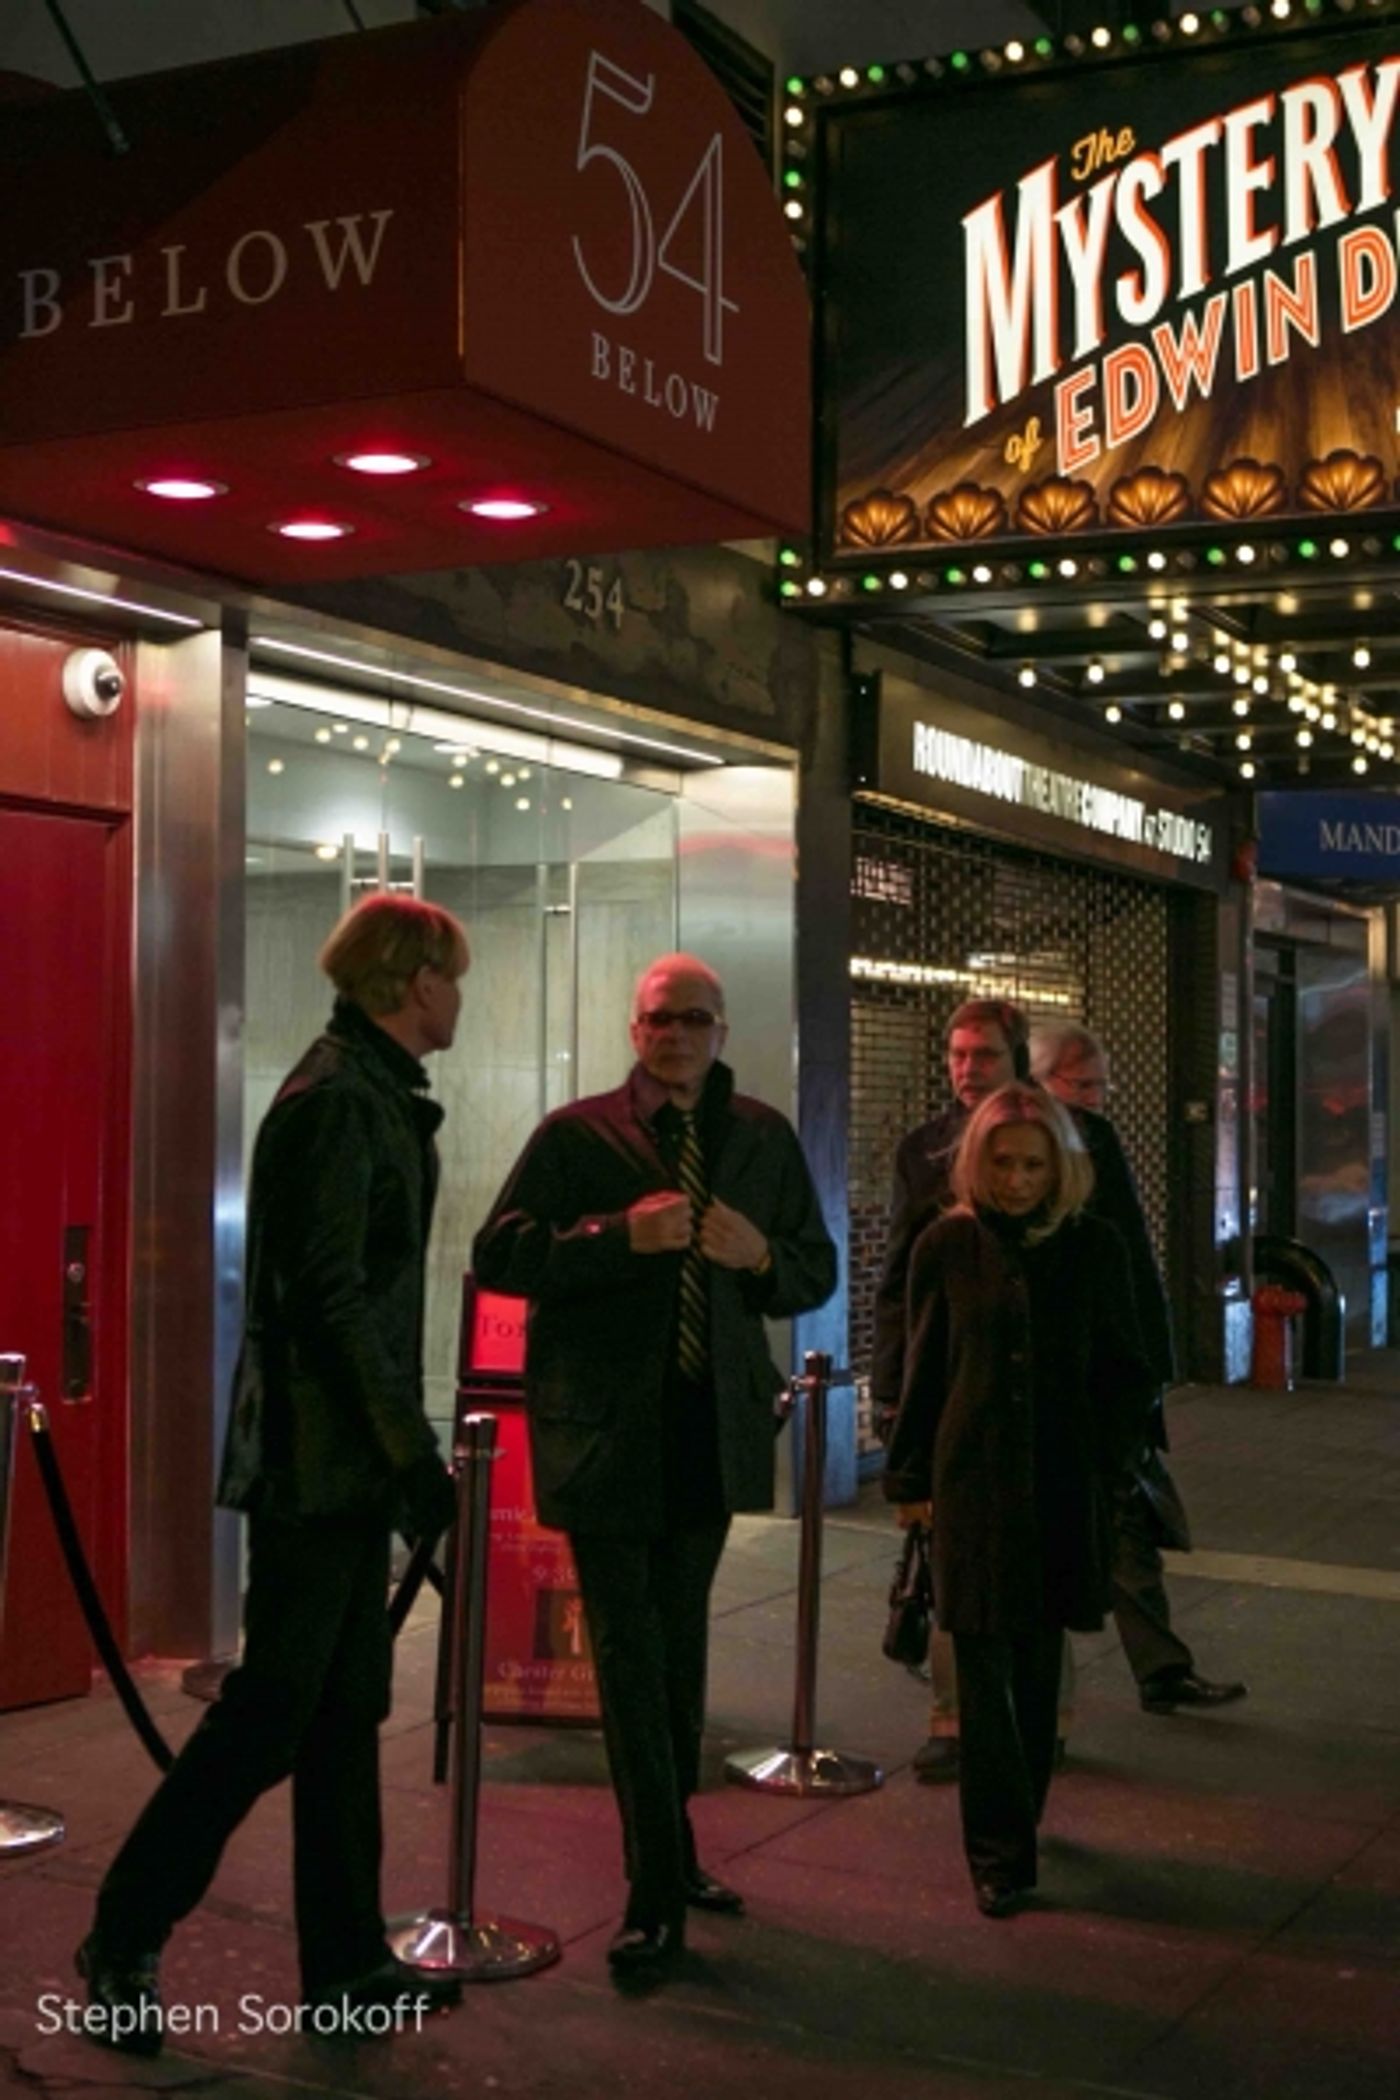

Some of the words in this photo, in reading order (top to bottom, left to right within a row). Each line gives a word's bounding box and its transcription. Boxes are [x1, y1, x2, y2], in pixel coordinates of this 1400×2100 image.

[572, 51, 740, 367] 54
[1070, 127, 1136, 180] The
[18, 210, 394, 339] BELOW
[961, 54, 1400, 429] MYSTERY
[590, 332, 720, 433] BELOW
[1004, 417, 1042, 471] of
[1055, 250, 1319, 477] EDWIN
[564, 559, 624, 629] 254
